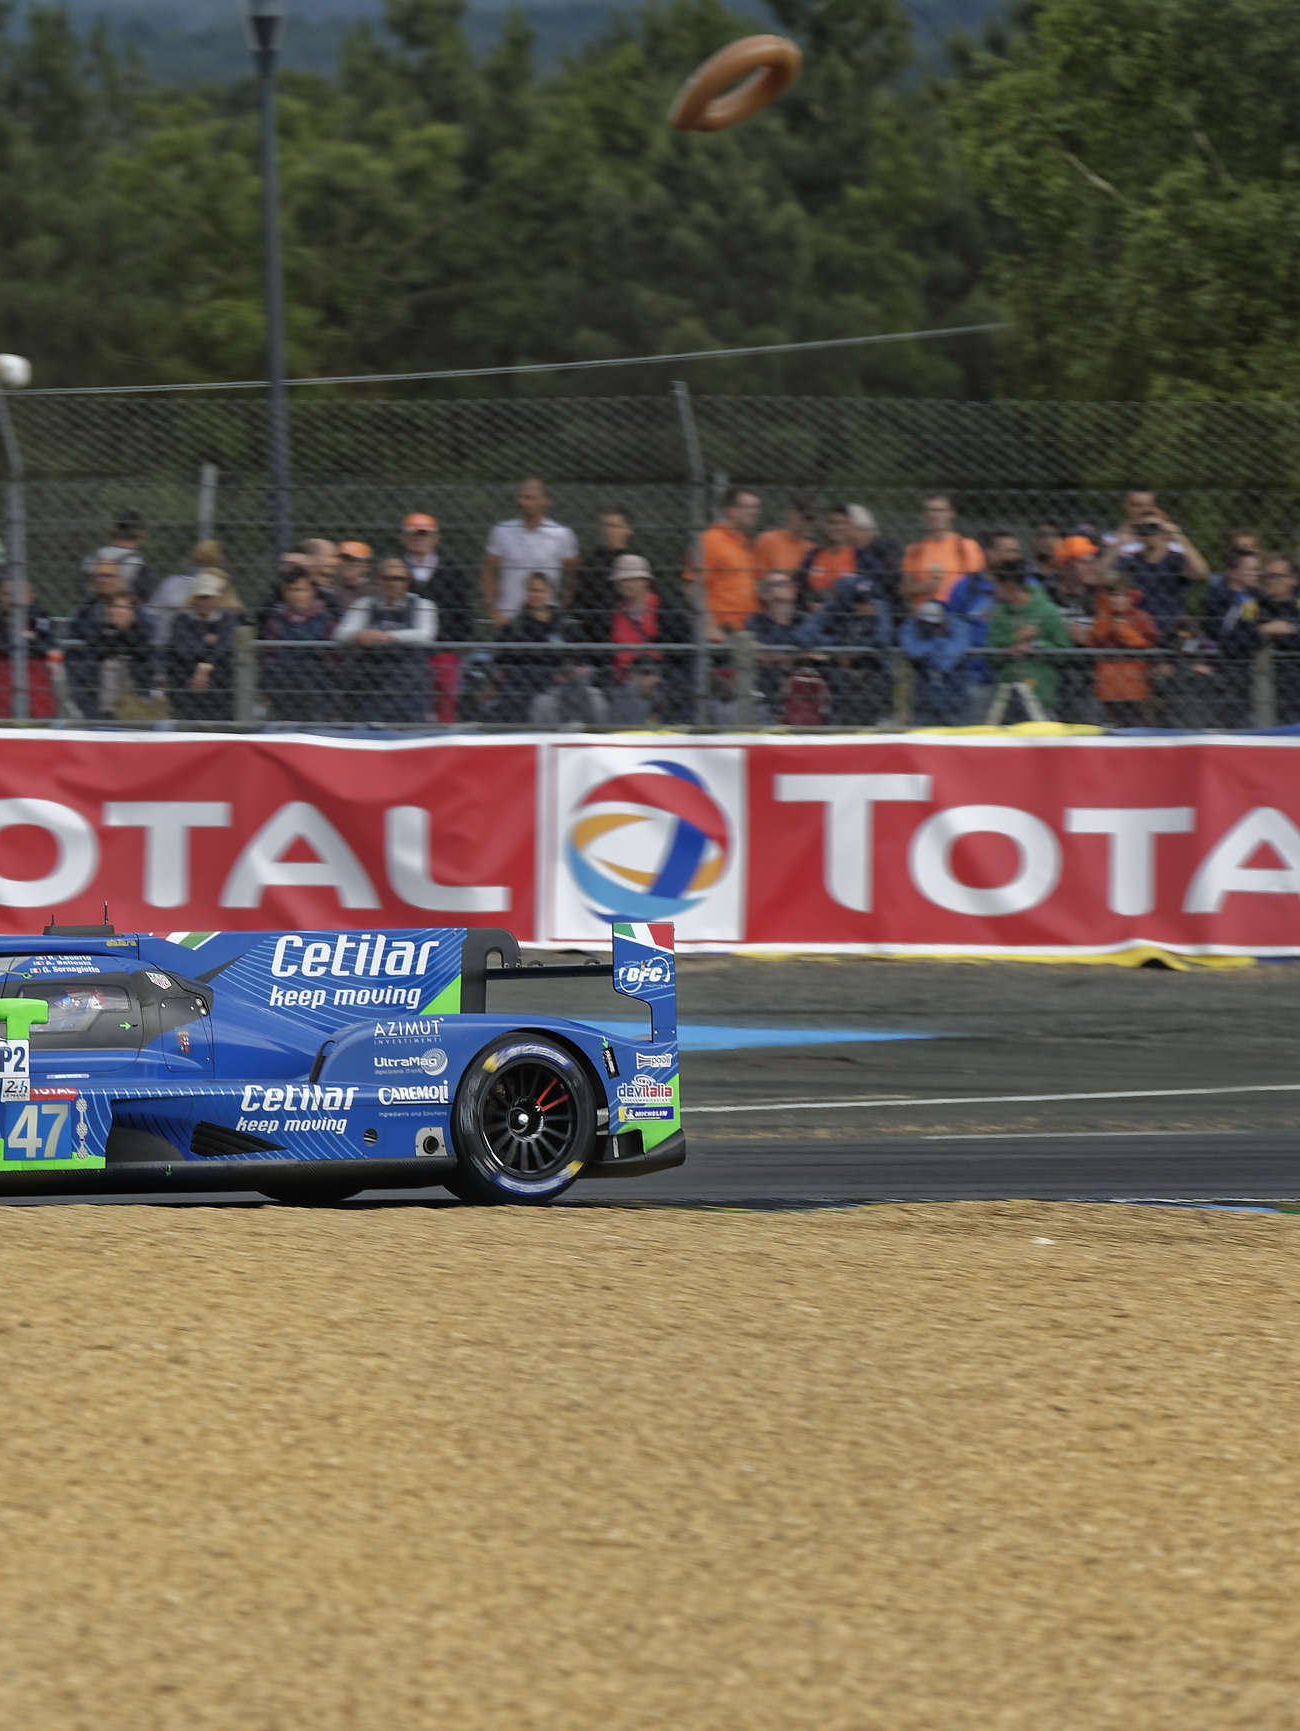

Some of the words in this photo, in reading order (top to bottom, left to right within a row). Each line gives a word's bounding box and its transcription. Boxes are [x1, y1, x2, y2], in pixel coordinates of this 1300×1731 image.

[271, 934, 440, 977] Cetilar
[269, 985, 326, 1009] keep
[333, 985, 422, 1010] moving
[0, 1046, 26, 1073] P2
[373, 1056, 438, 1068] UltraMag
[240, 1084, 360, 1112] Cetilar
[618, 1083, 673, 1098] devitalia
[7, 1104, 69, 1158] 47
[235, 1116, 280, 1134] keep
[283, 1116, 348, 1135] moving
